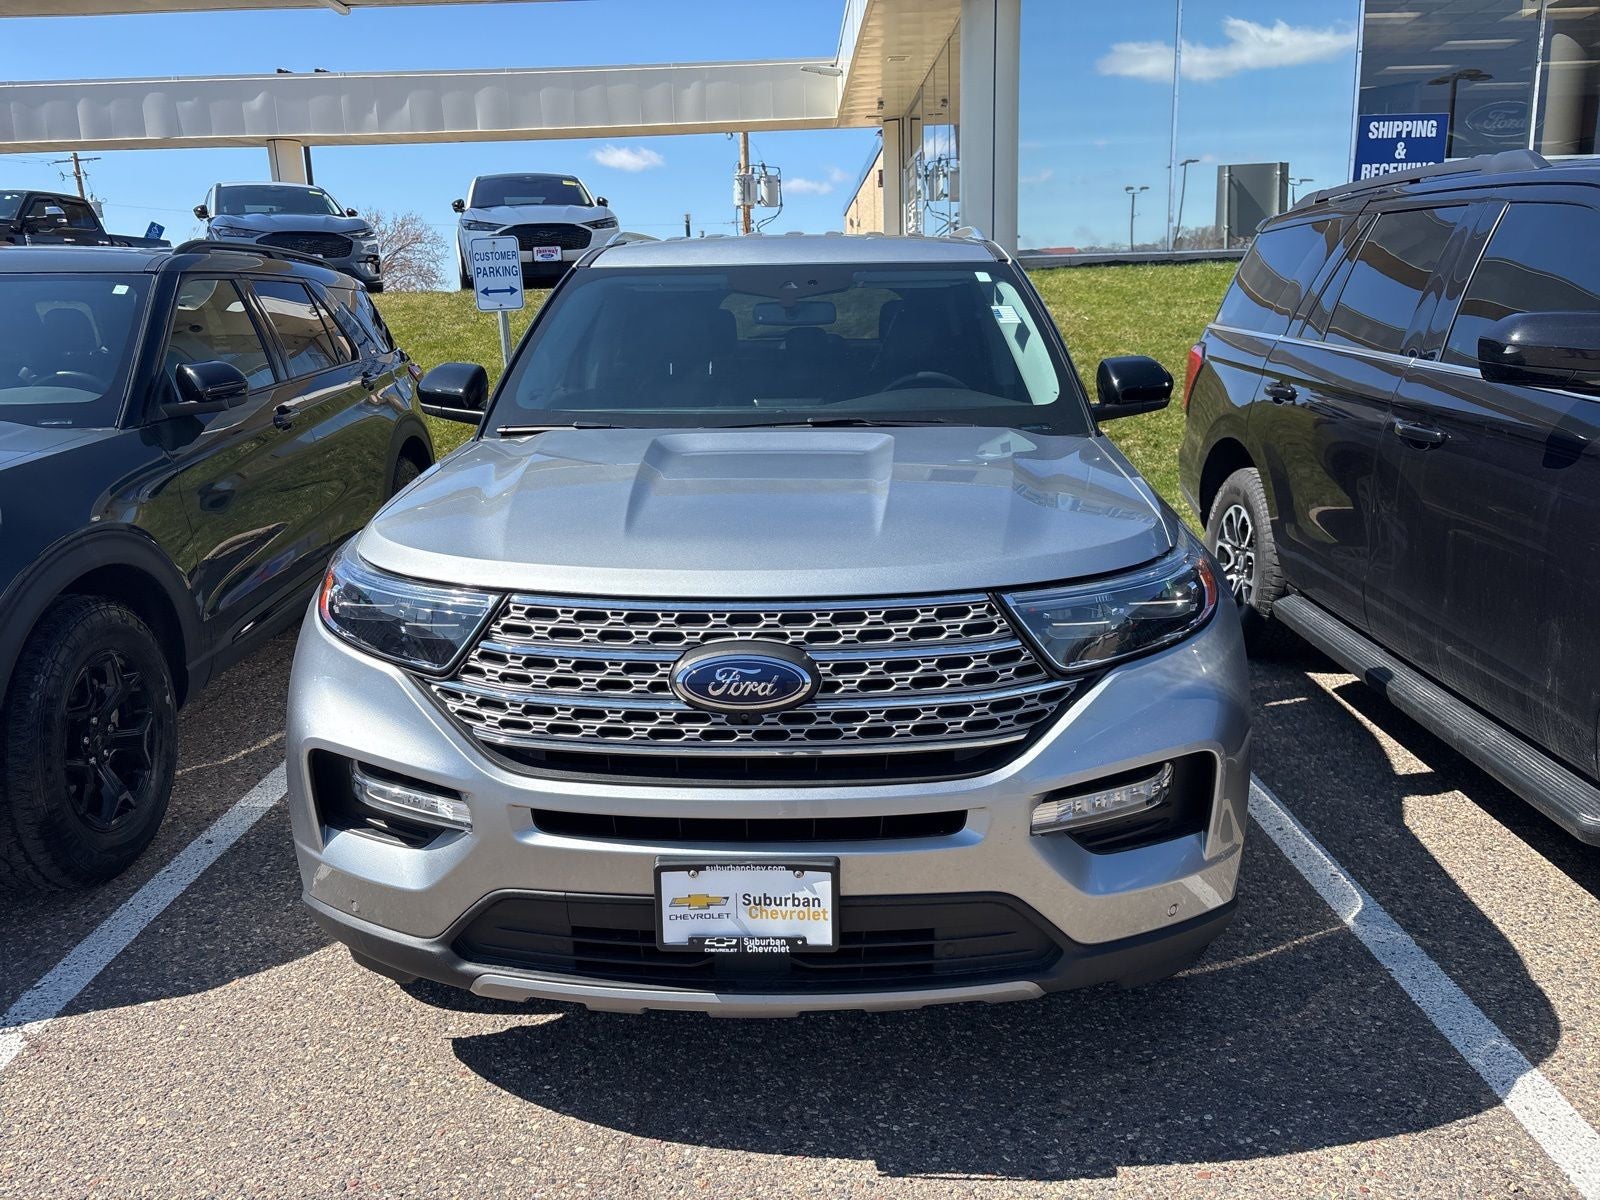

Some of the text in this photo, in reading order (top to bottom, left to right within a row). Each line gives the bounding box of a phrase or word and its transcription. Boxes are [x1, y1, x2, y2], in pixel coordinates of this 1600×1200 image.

[1368, 120, 1438, 139] SHIPPING
[1394, 141, 1407, 159] &
[474, 251, 517, 262] CUSTOMER
[476, 265, 519, 278] PARKING
[708, 667, 779, 697] Ford
[742, 893, 821, 908] Suburban
[669, 912, 731, 920] CHEVROLET
[749, 905, 829, 922] Chevrolet
[743, 937, 786, 946] Suburban
[746, 944, 790, 953] Chevrolet
